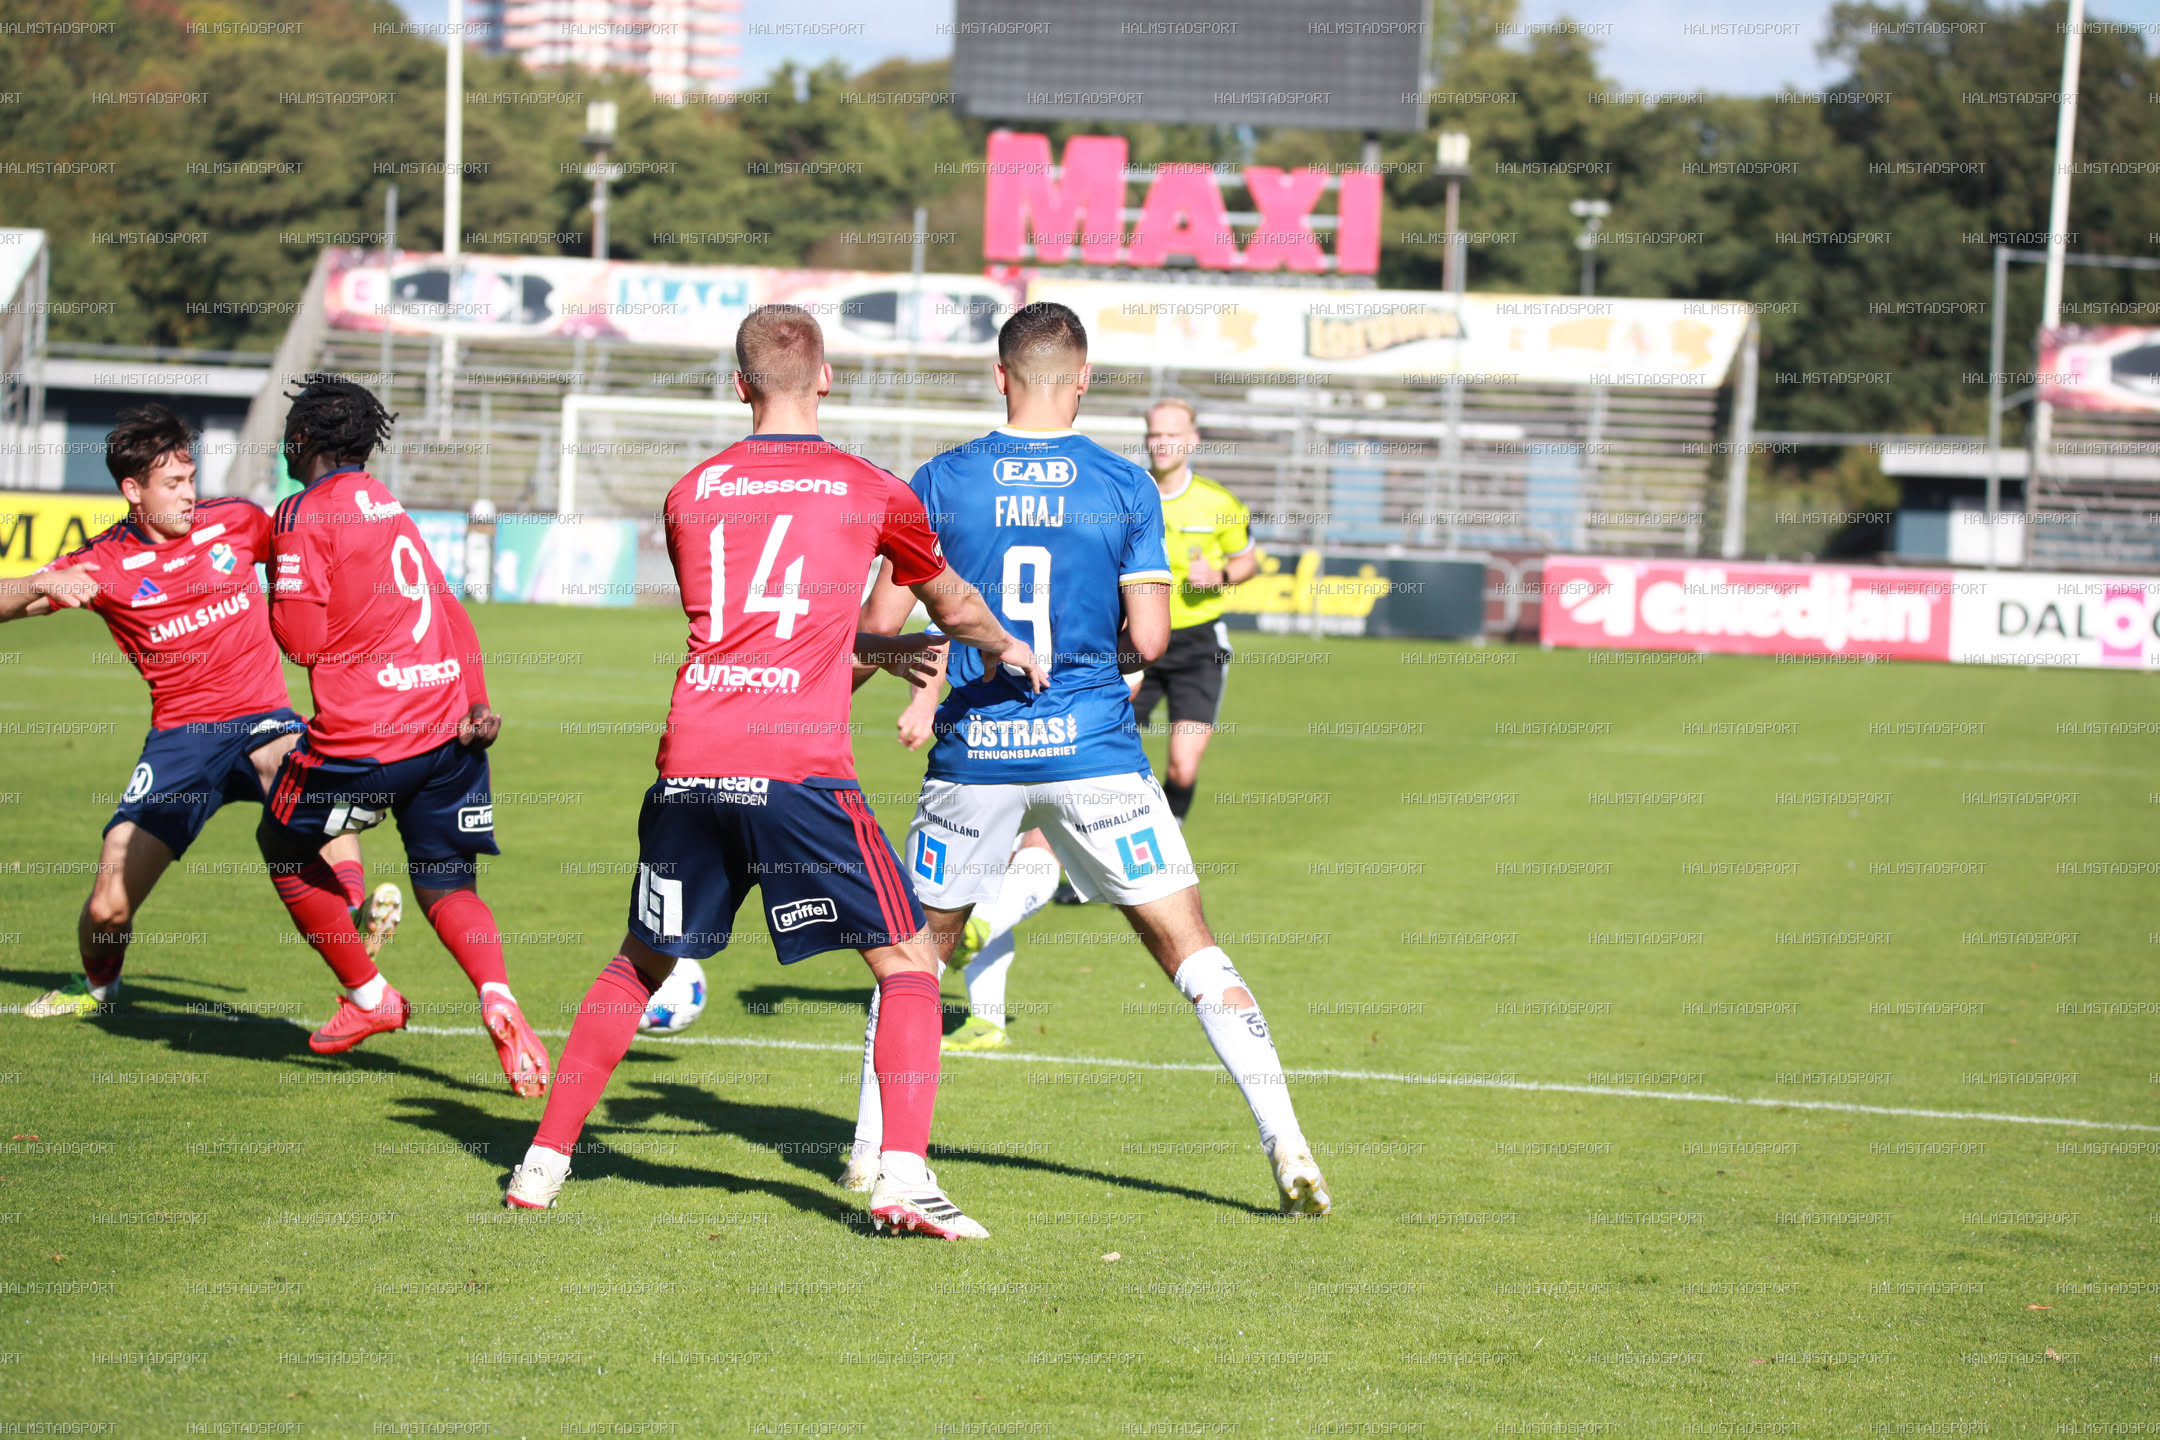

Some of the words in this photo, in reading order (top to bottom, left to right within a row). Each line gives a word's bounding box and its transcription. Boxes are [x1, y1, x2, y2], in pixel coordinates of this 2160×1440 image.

[701, 469, 848, 500] Fellessons
[1002, 461, 1070, 483] EAB
[995, 496, 1065, 527] FARAJ
[391, 535, 431, 644] 9
[708, 514, 810, 642] 14
[149, 592, 249, 643] EMILSHUS
[1002, 545, 1052, 677] 9
[686, 657, 800, 691] dynacon
[967, 714, 1067, 748] ÖSTRAS
[967, 745, 1078, 760] STENUGNSBAGERIET
[719, 791, 767, 806] SWEDEN
[781, 903, 828, 927] griffel
